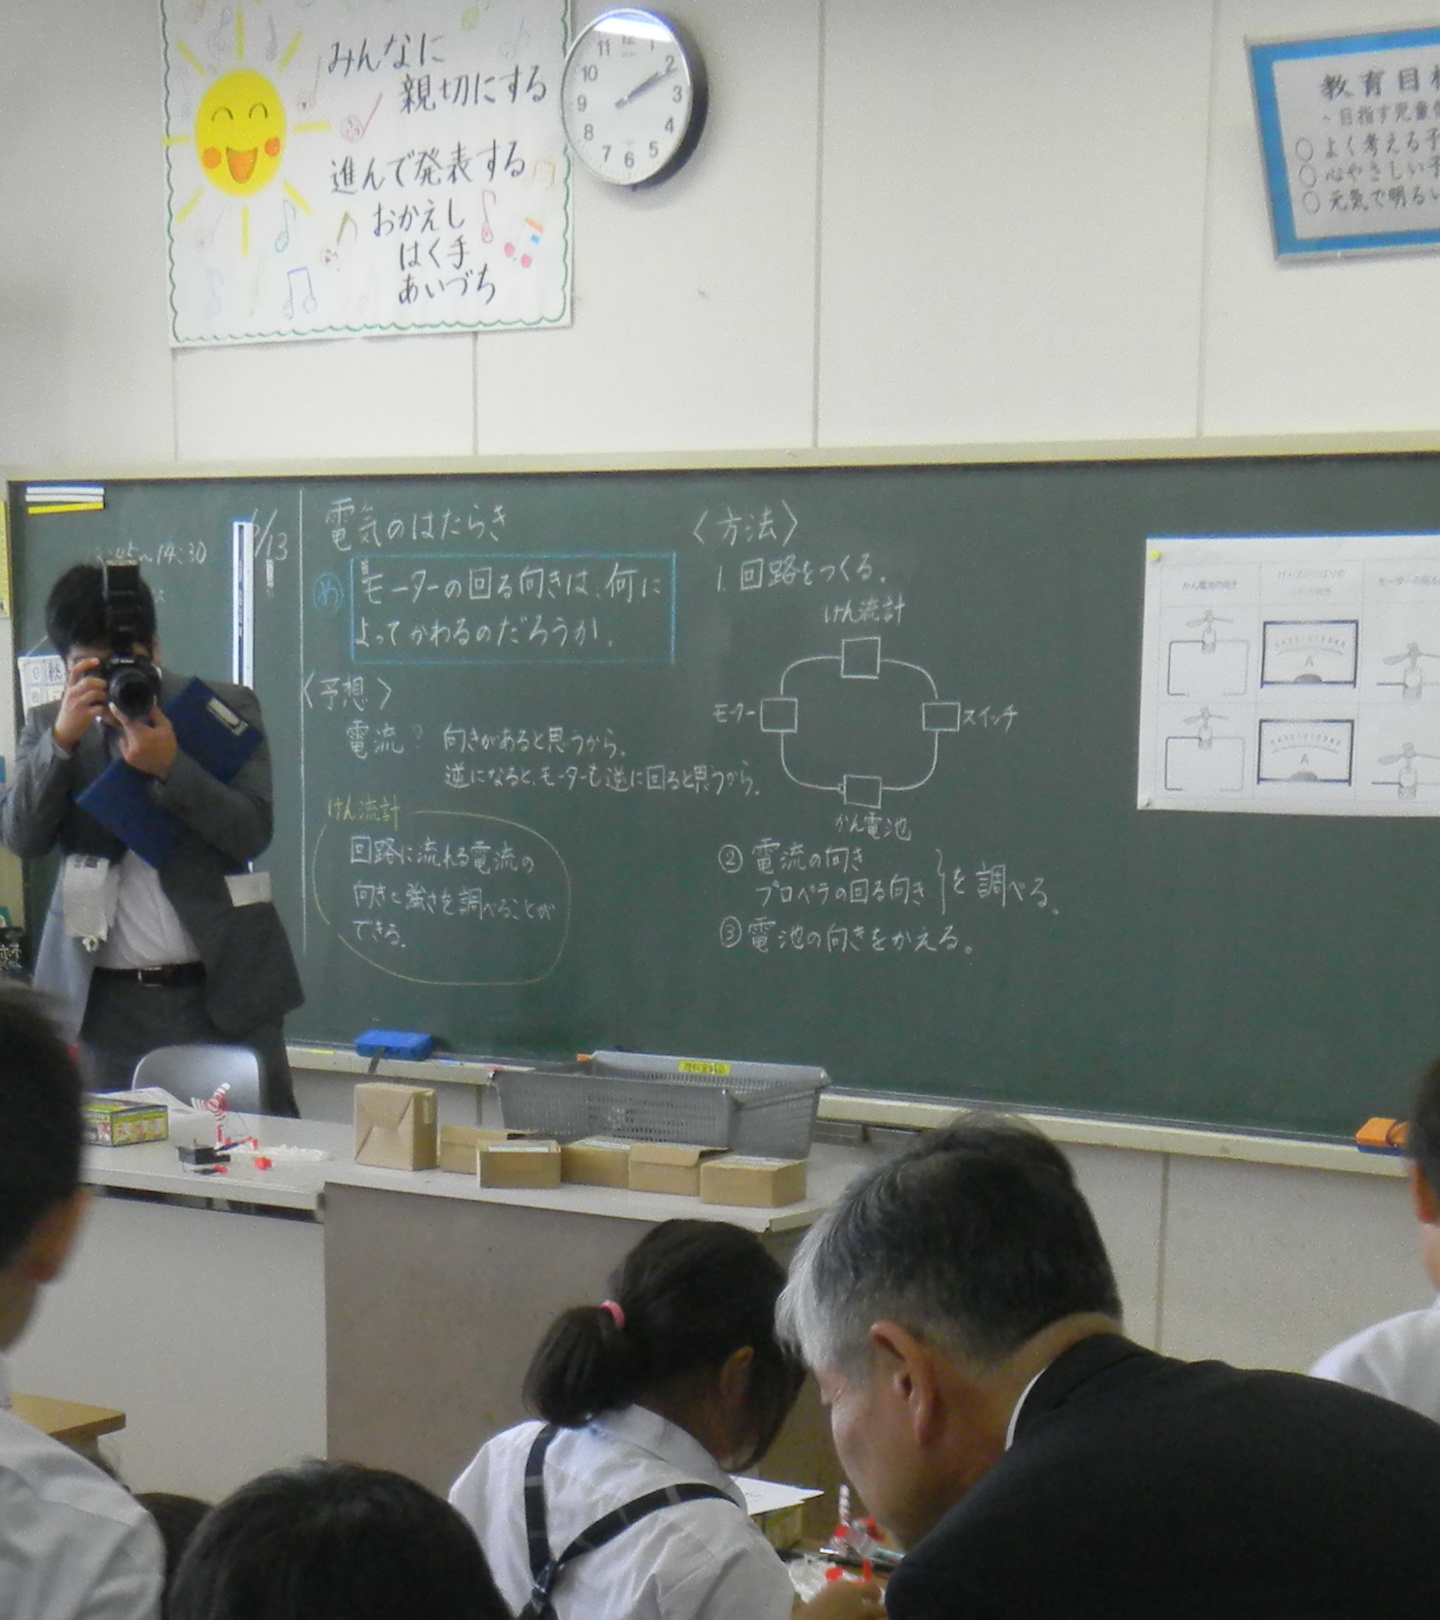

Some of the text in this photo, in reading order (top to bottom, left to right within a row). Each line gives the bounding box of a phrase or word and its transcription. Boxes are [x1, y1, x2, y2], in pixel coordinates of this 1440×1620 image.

[326, 30, 446, 76] みんなに
[581, 64, 599, 83] 10
[398, 64, 547, 115] 親切にする
[672, 84, 683, 104] 3
[576, 94, 588, 113] 9
[583, 123, 595, 141] 8
[664, 117, 675, 134] 4
[602, 145, 612, 163] 7
[648, 140, 660, 159] 5
[329, 139, 527, 195] 進んで発表する
[623, 151, 635, 170] 6
[372, 198, 465, 237] おかえし
[398, 238, 472, 270] はく手
[397, 264, 497, 304] あいづち
[324, 497, 506, 551] 電気のはたらき
